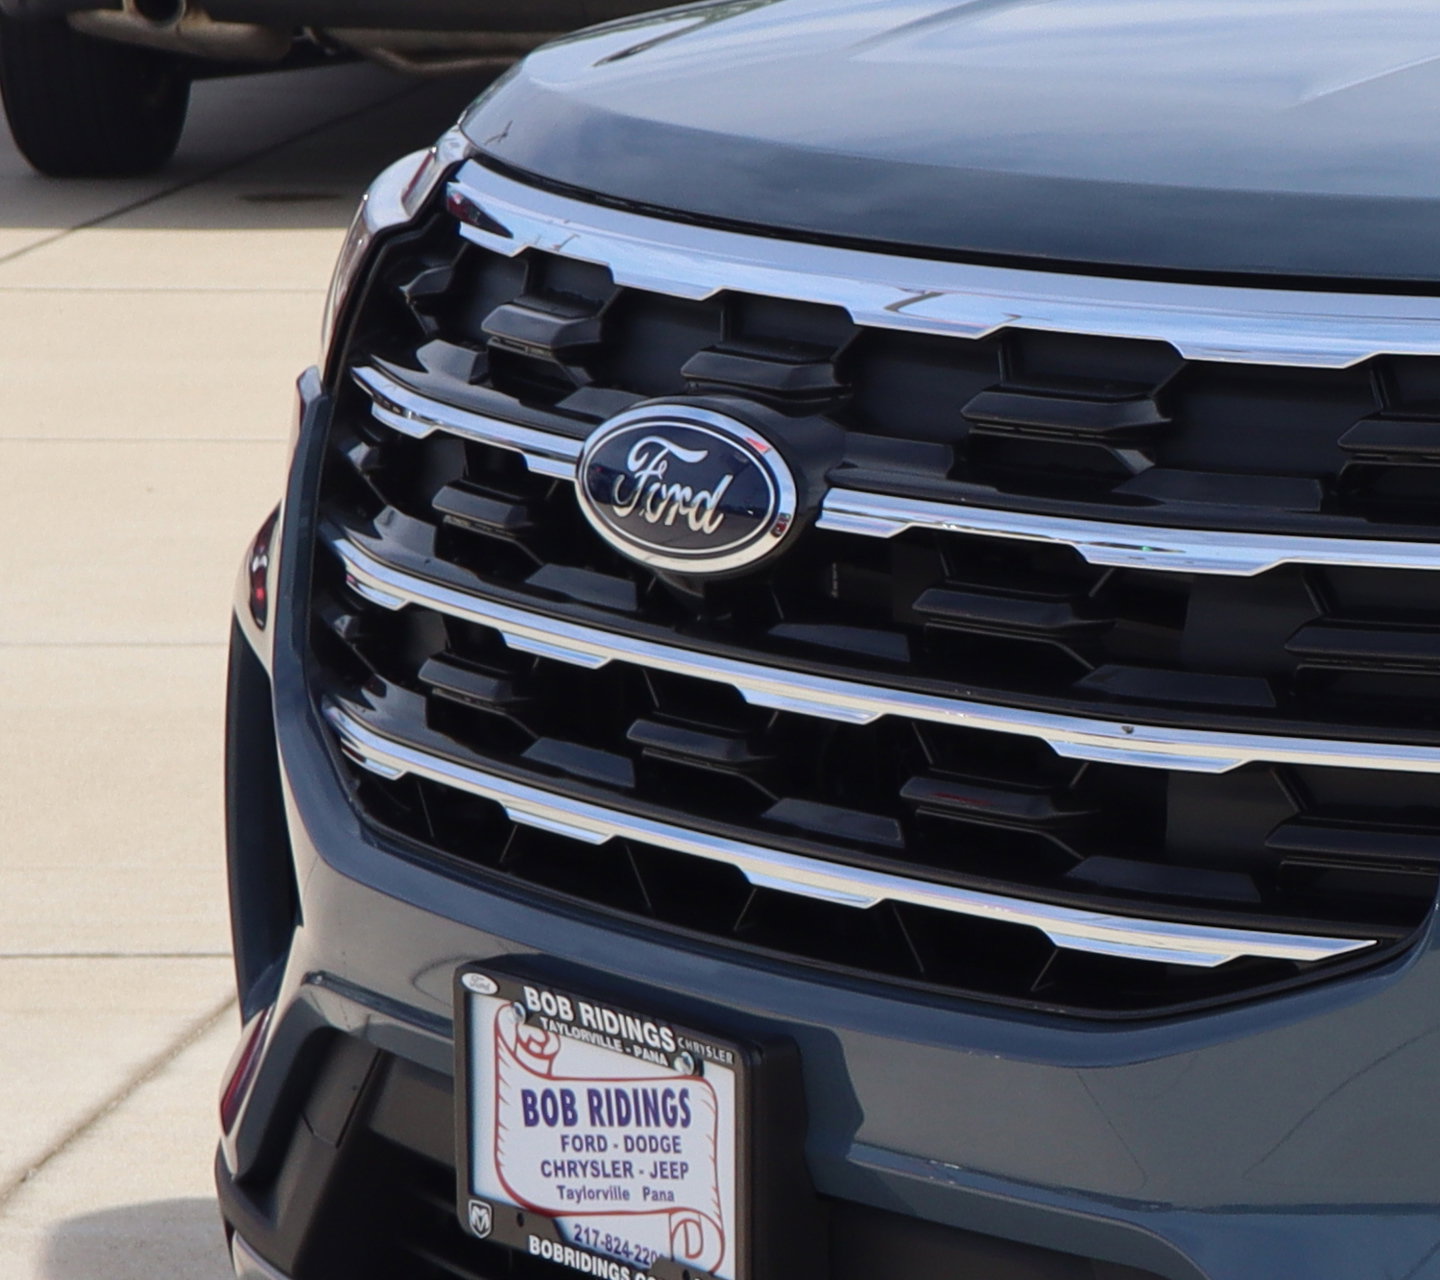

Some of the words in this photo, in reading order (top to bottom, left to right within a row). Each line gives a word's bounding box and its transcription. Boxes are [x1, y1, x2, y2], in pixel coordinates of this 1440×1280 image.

[613, 435, 734, 535] Ford
[523, 986, 574, 1021] BOB
[578, 1002, 676, 1052] RIDINGS
[540, 1017, 623, 1053] TAYLORVILLE
[634, 1047, 669, 1066] PANA
[677, 1036, 734, 1065] CHRYSLER
[521, 1087, 578, 1128] BOB
[588, 1087, 692, 1128] RIDINGS
[560, 1134, 608, 1153] FORD
[624, 1134, 682, 1154] DODGE
[540, 1160, 635, 1179] CHRYSLER
[649, 1161, 689, 1180] JEEP
[556, 1185, 630, 1204] Taylorville
[643, 1186, 675, 1202] Pana
[573, 1224, 665, 1266] 217-824-220
